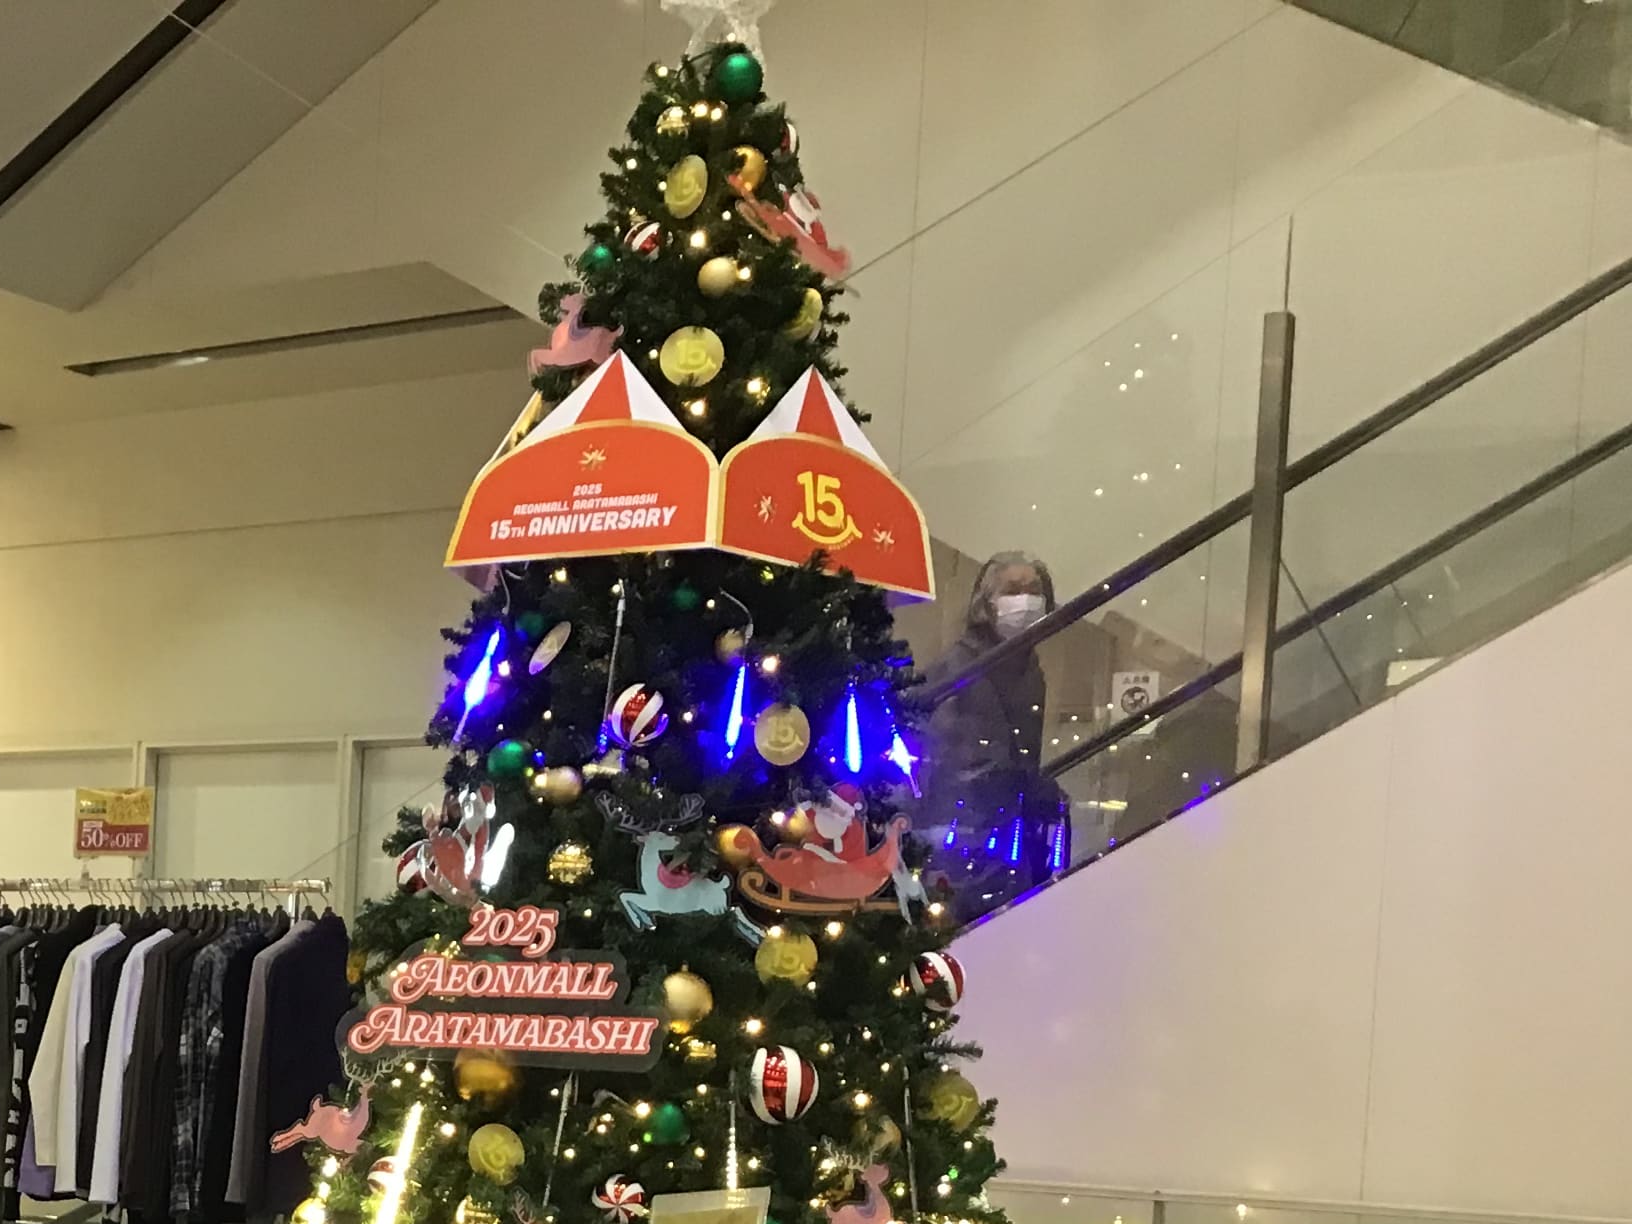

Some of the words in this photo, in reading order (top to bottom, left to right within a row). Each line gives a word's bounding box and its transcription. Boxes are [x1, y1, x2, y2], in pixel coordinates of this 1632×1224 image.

[513, 500, 570, 516] AEONMALL
[572, 493, 658, 511] ARATAMABASHI
[573, 483, 602, 496] 2025
[796, 471, 844, 528] 15
[527, 505, 677, 537] ANNIVERSARY
[81, 827, 144, 849] 50%OFF
[463, 906, 560, 958] 2025
[390, 953, 618, 1003] AEONMALL
[348, 1004, 660, 1055] ARATAMABASHI
